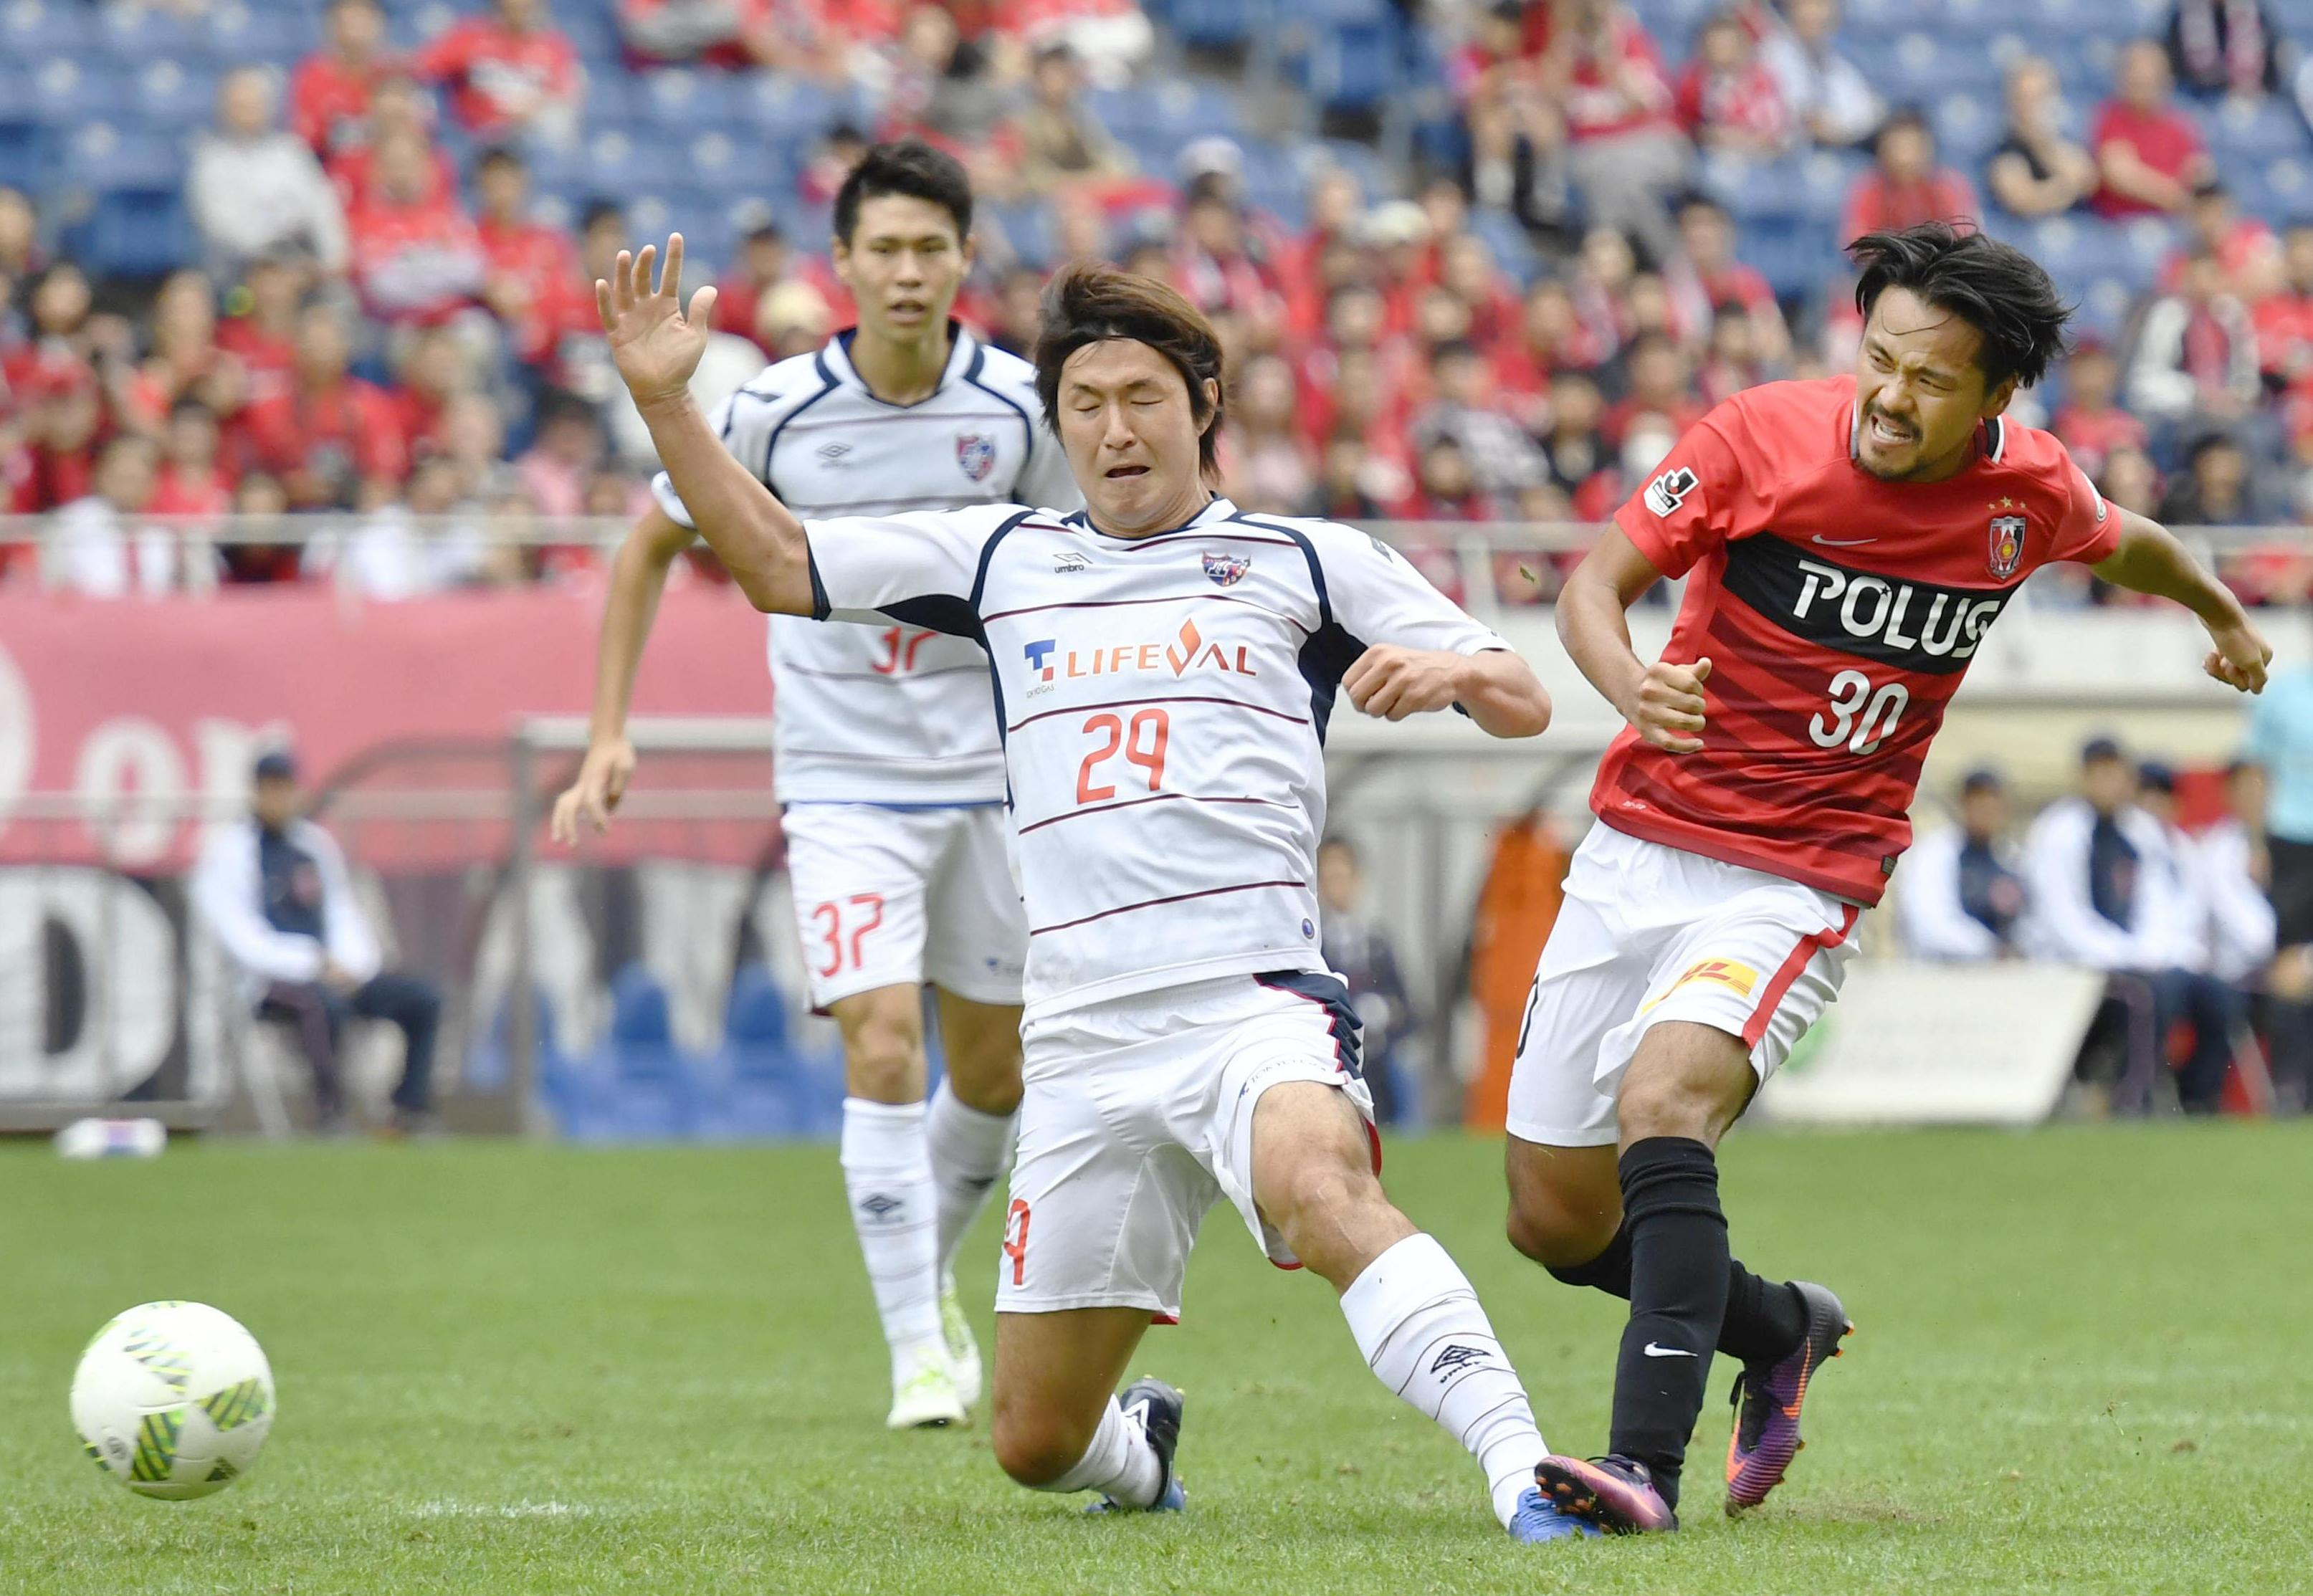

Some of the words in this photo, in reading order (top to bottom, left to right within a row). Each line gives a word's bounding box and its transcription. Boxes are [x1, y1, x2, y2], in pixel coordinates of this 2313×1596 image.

[1054, 564, 1084, 573] umbro
[1793, 560, 2000, 658] POLUS
[1067, 617, 1256, 678] LIFEVAL
[1808, 670, 1909, 755] 30
[1076, 708, 1169, 805] 29
[811, 892, 884, 978] 37
